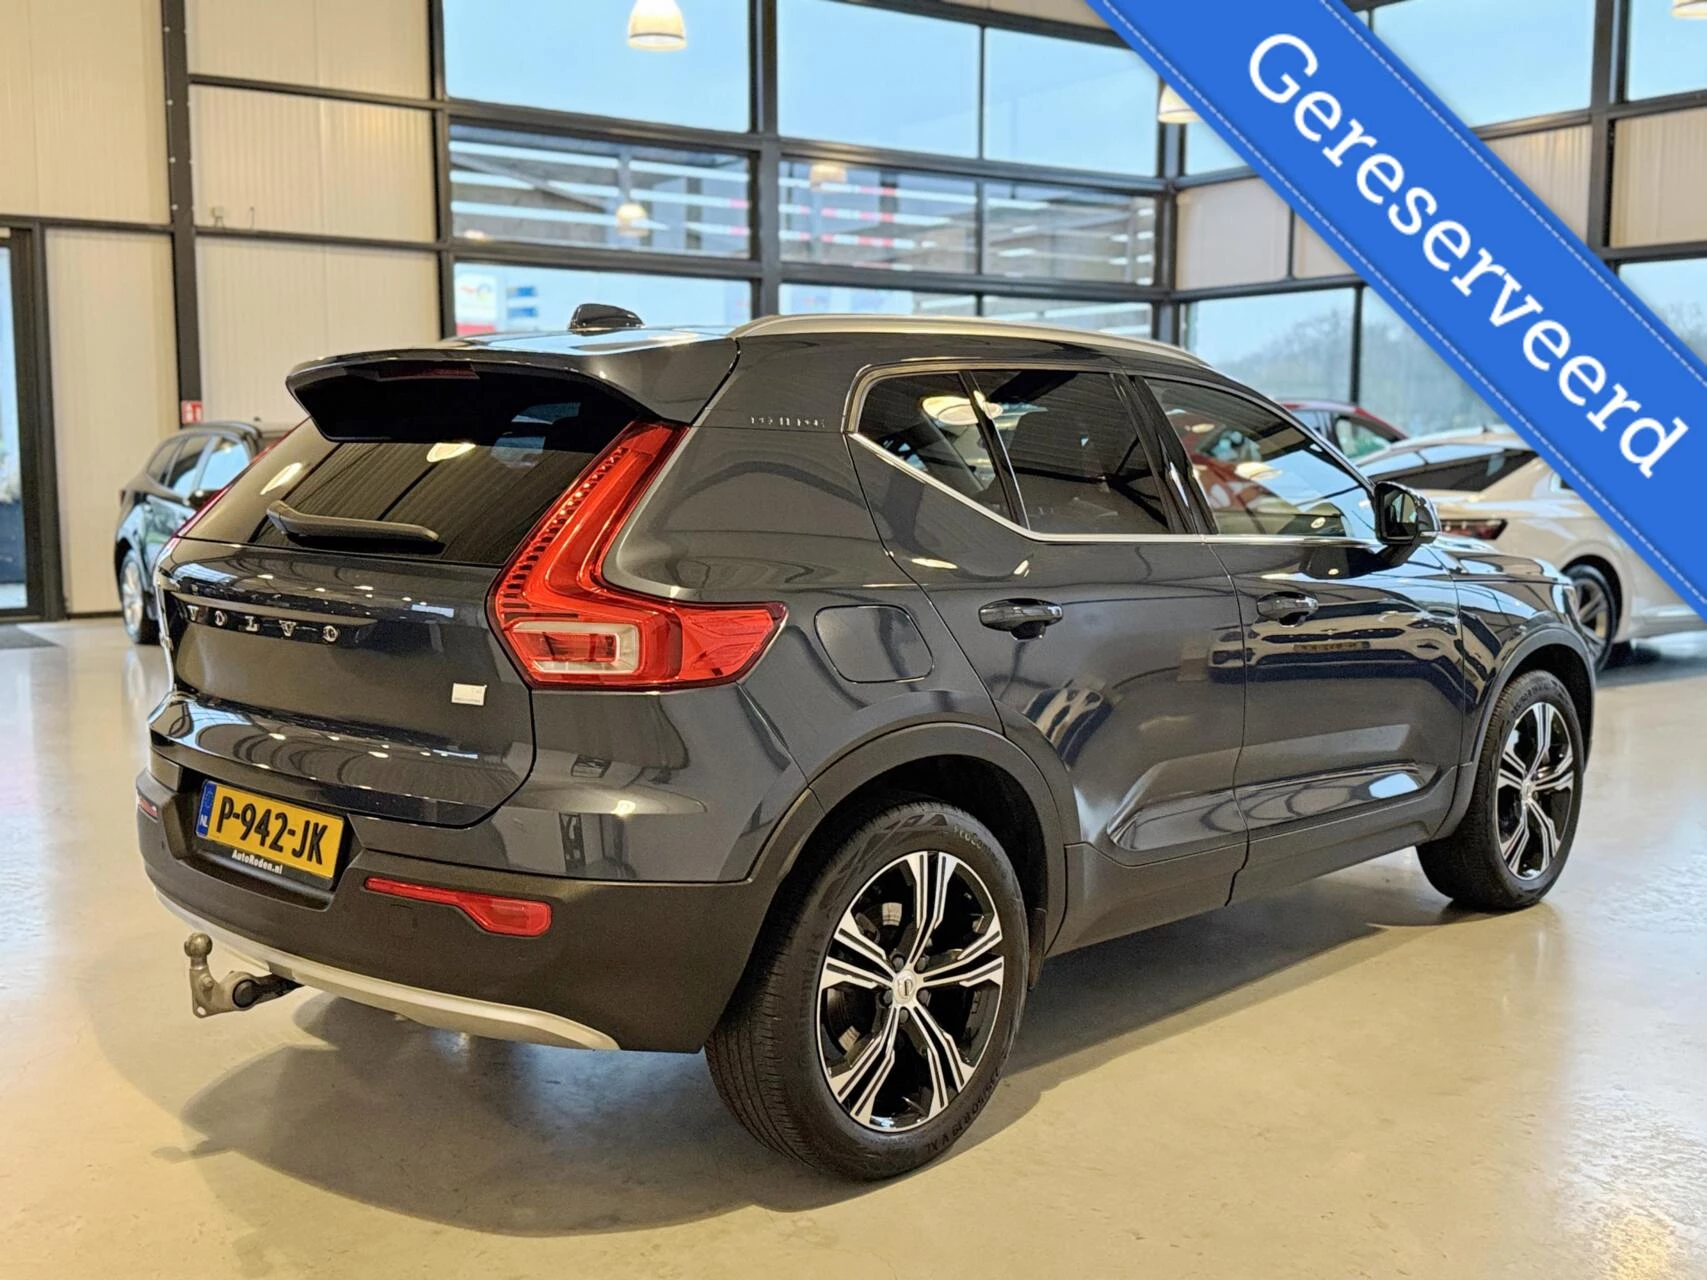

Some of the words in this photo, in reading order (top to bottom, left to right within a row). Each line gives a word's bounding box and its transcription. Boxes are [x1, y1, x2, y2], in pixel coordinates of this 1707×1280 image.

[187, 605, 339, 642] VOLVO
[200, 814, 208, 828] NL
[216, 795, 328, 866] P-942-JK
[231, 849, 283, 875] AutoRoden.nl
